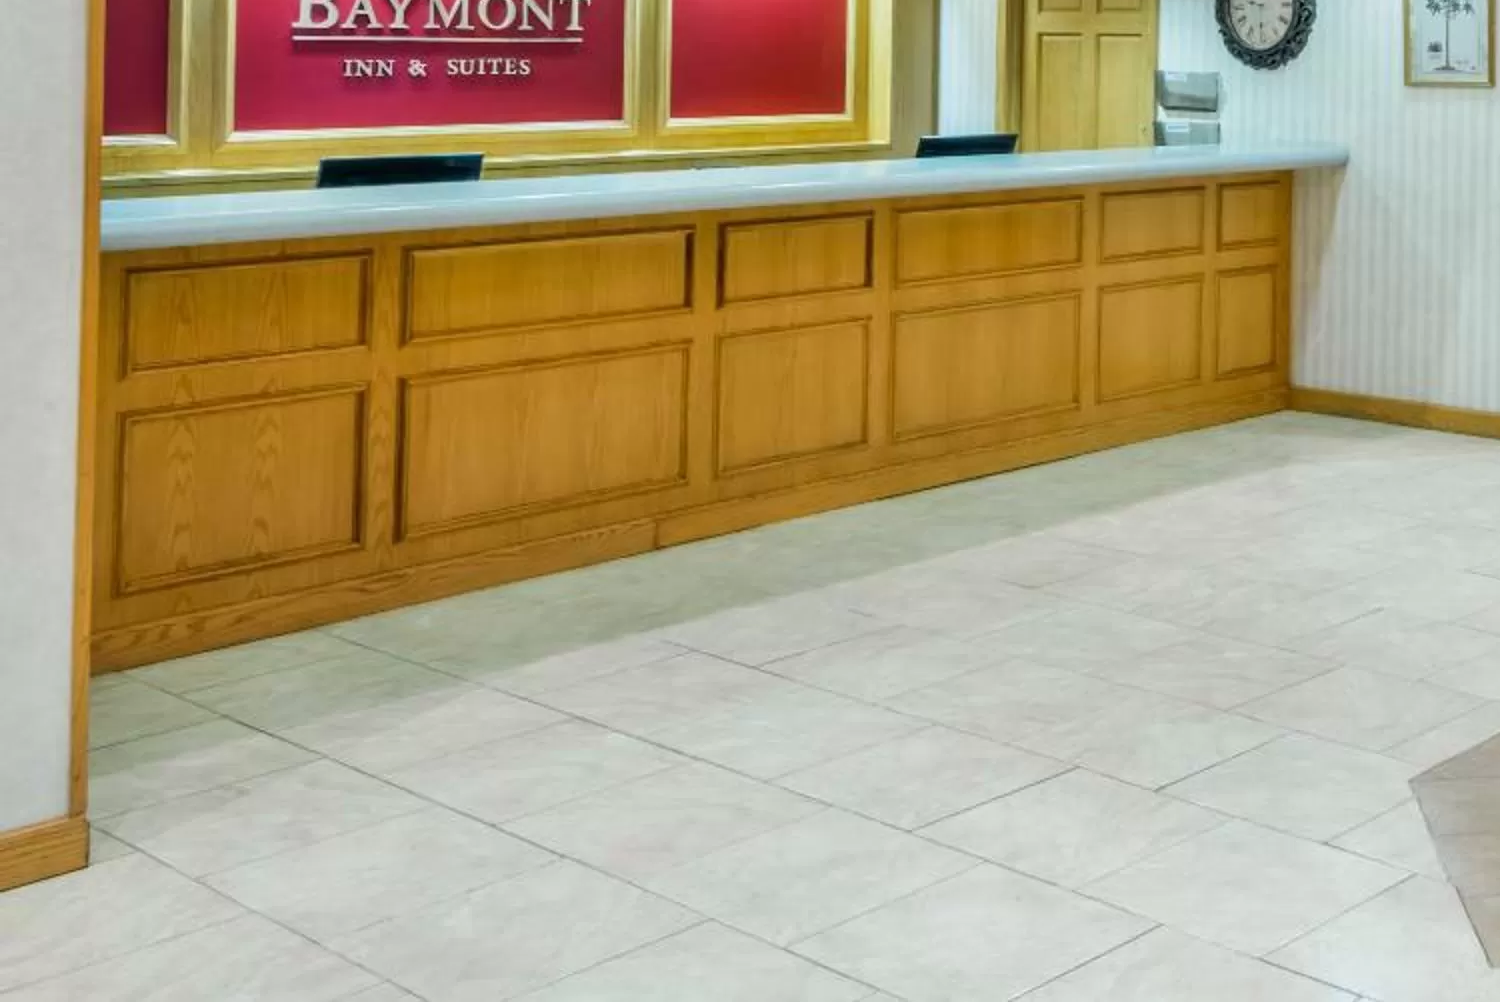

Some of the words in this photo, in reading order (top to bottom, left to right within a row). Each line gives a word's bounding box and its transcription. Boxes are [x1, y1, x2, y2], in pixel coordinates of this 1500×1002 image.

[343, 58, 396, 78] INN
[407, 58, 428, 78] &
[446, 56, 532, 77] SUITES
